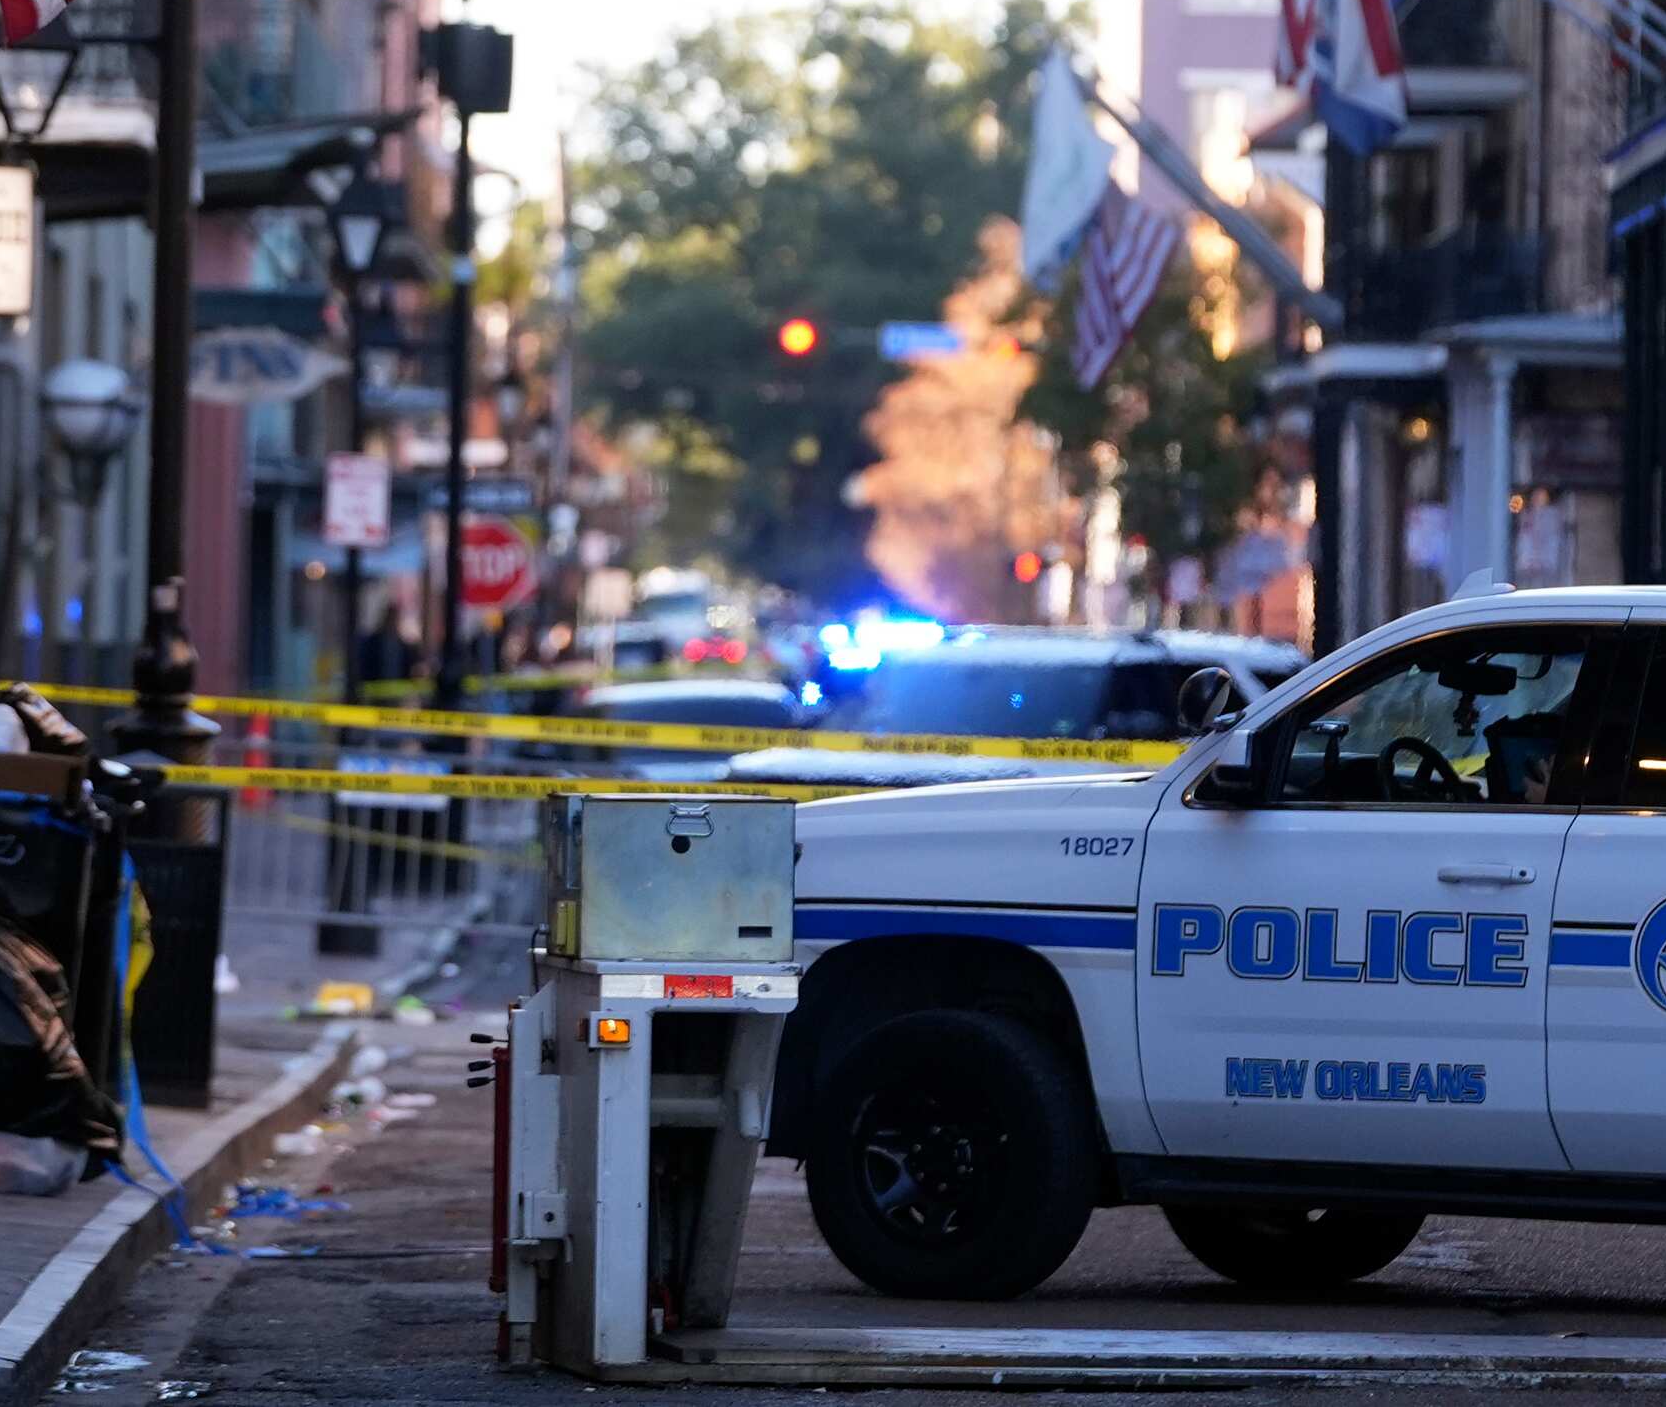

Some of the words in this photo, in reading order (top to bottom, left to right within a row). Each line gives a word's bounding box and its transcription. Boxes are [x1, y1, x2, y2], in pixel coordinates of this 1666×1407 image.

[1060, 837, 1134, 857] 18027
[1151, 903, 1530, 989] POLICE
[1225, 1057, 1309, 1099] NEW
[1314, 1060, 1487, 1104] ORLEANS
